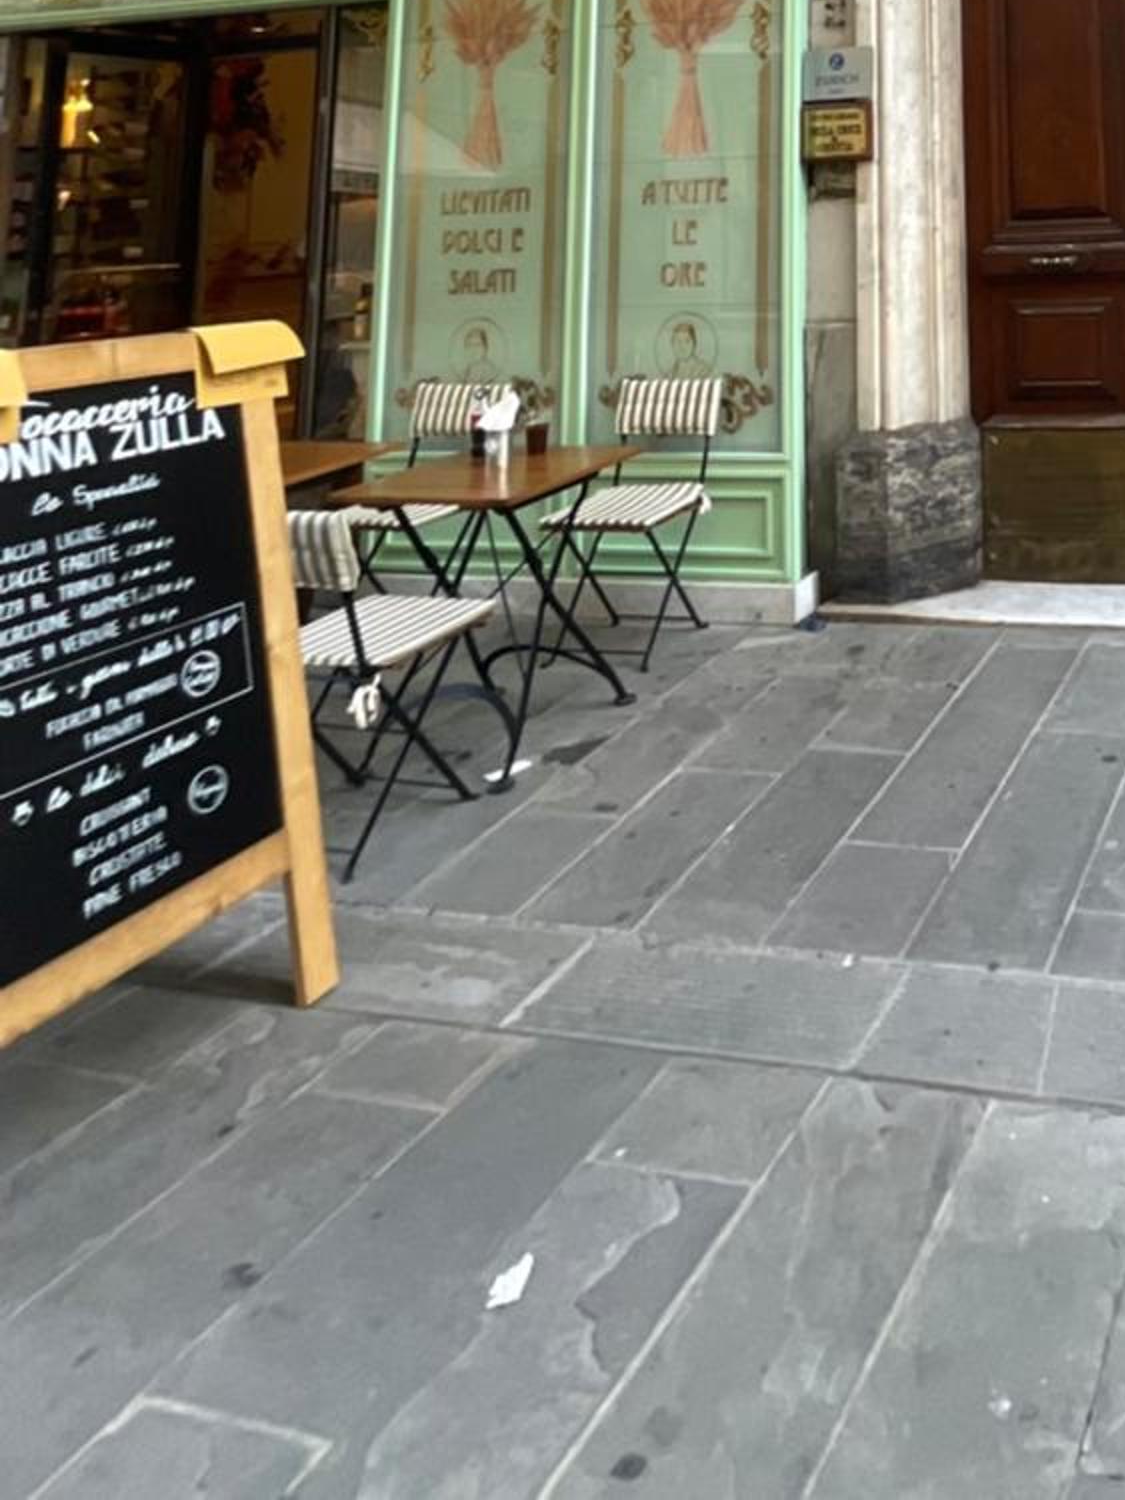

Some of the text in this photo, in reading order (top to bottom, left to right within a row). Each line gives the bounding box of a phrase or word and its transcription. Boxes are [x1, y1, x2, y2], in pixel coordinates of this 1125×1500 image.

[672, 219, 698, 246] LE
[448, 267, 516, 295] SALATI
[660, 260, 706, 288] ORE
[108, 408, 226, 461] ZULLA
